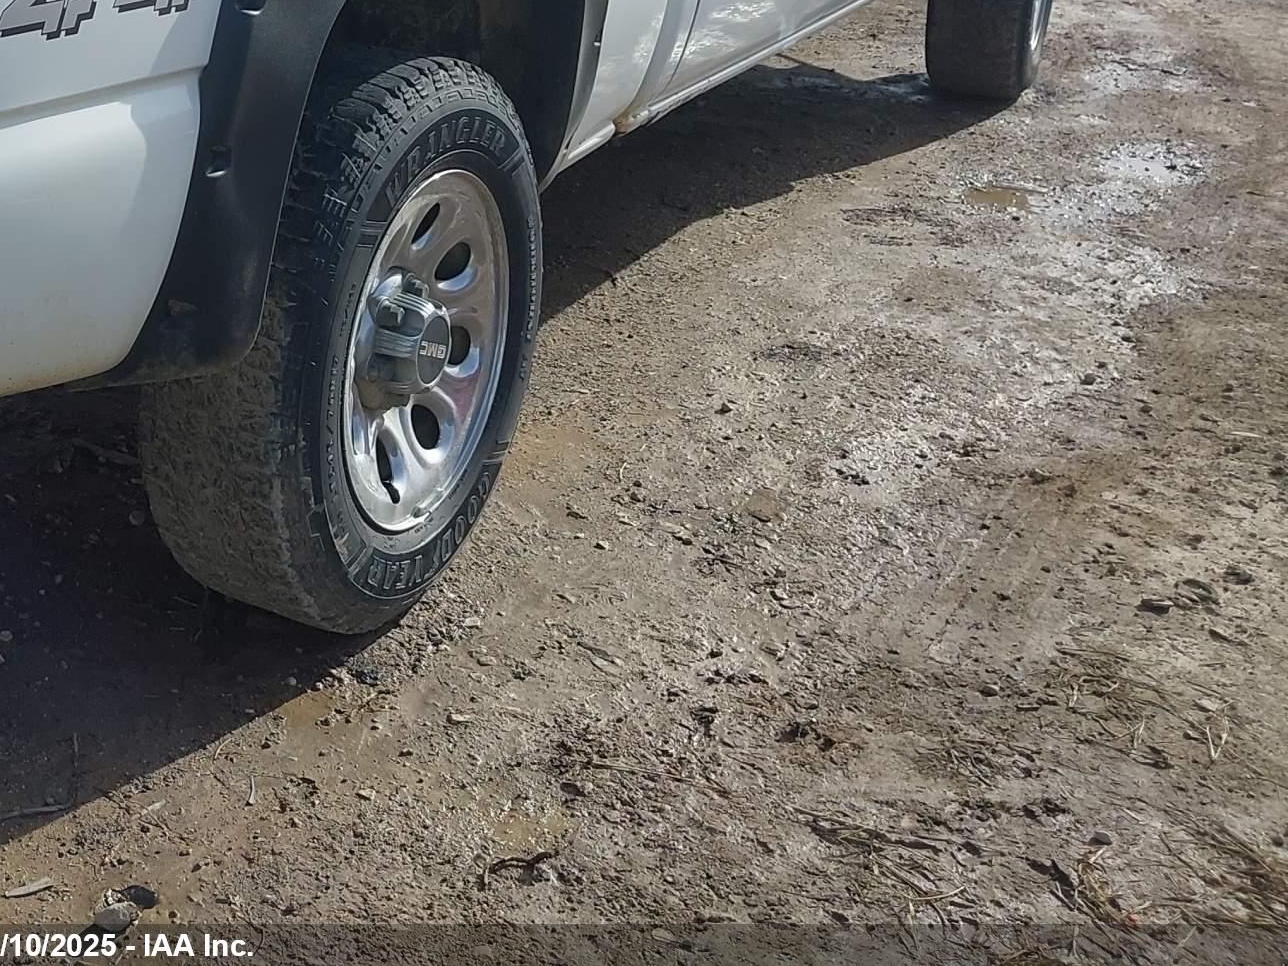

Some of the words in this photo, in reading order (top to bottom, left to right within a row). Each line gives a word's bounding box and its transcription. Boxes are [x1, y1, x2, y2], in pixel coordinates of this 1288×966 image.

[385, 116, 507, 209] WRANGLER
[419, 340, 447, 359] GMC
[367, 471, 491, 590] GOODYEAR
